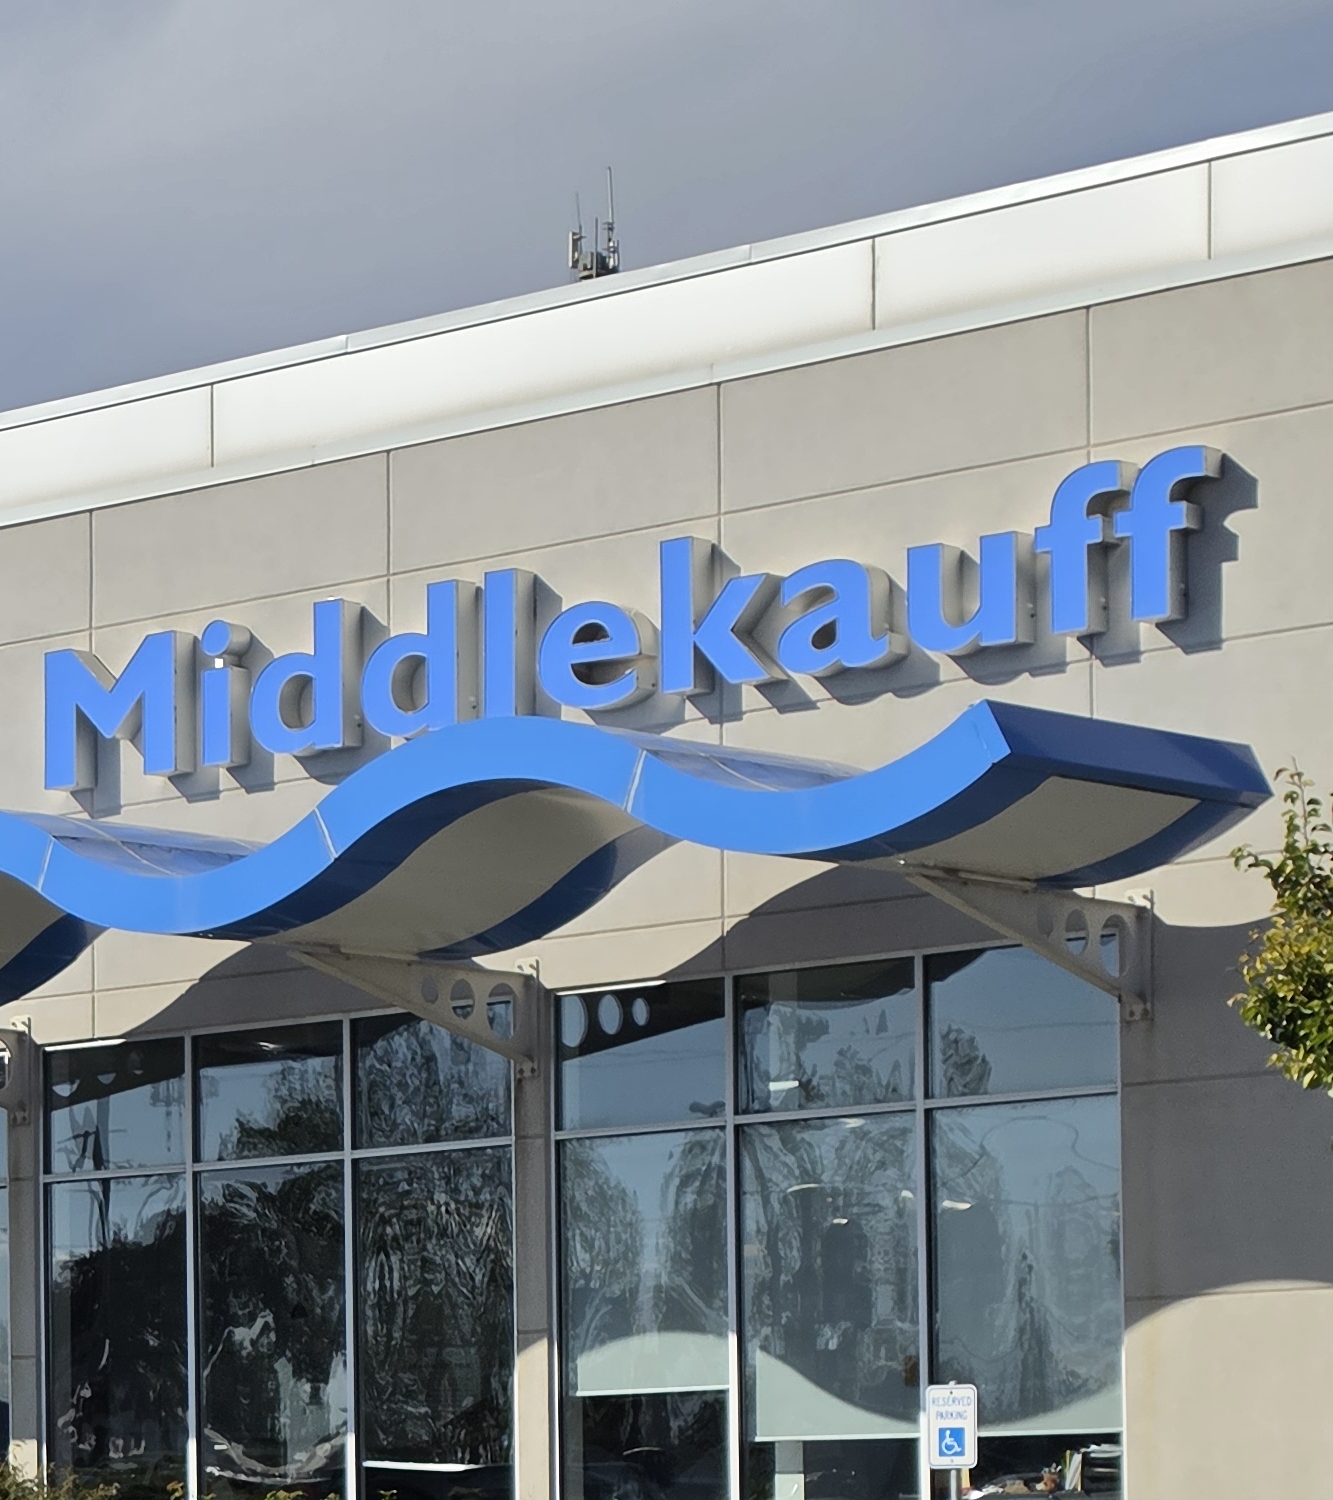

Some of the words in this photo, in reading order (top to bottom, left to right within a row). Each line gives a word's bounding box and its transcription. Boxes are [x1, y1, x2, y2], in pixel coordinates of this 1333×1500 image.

[44, 445, 1219, 791] Middlekauff
[932, 1397, 973, 1407] RESERVED
[936, 1411, 969, 1420] PARKING
